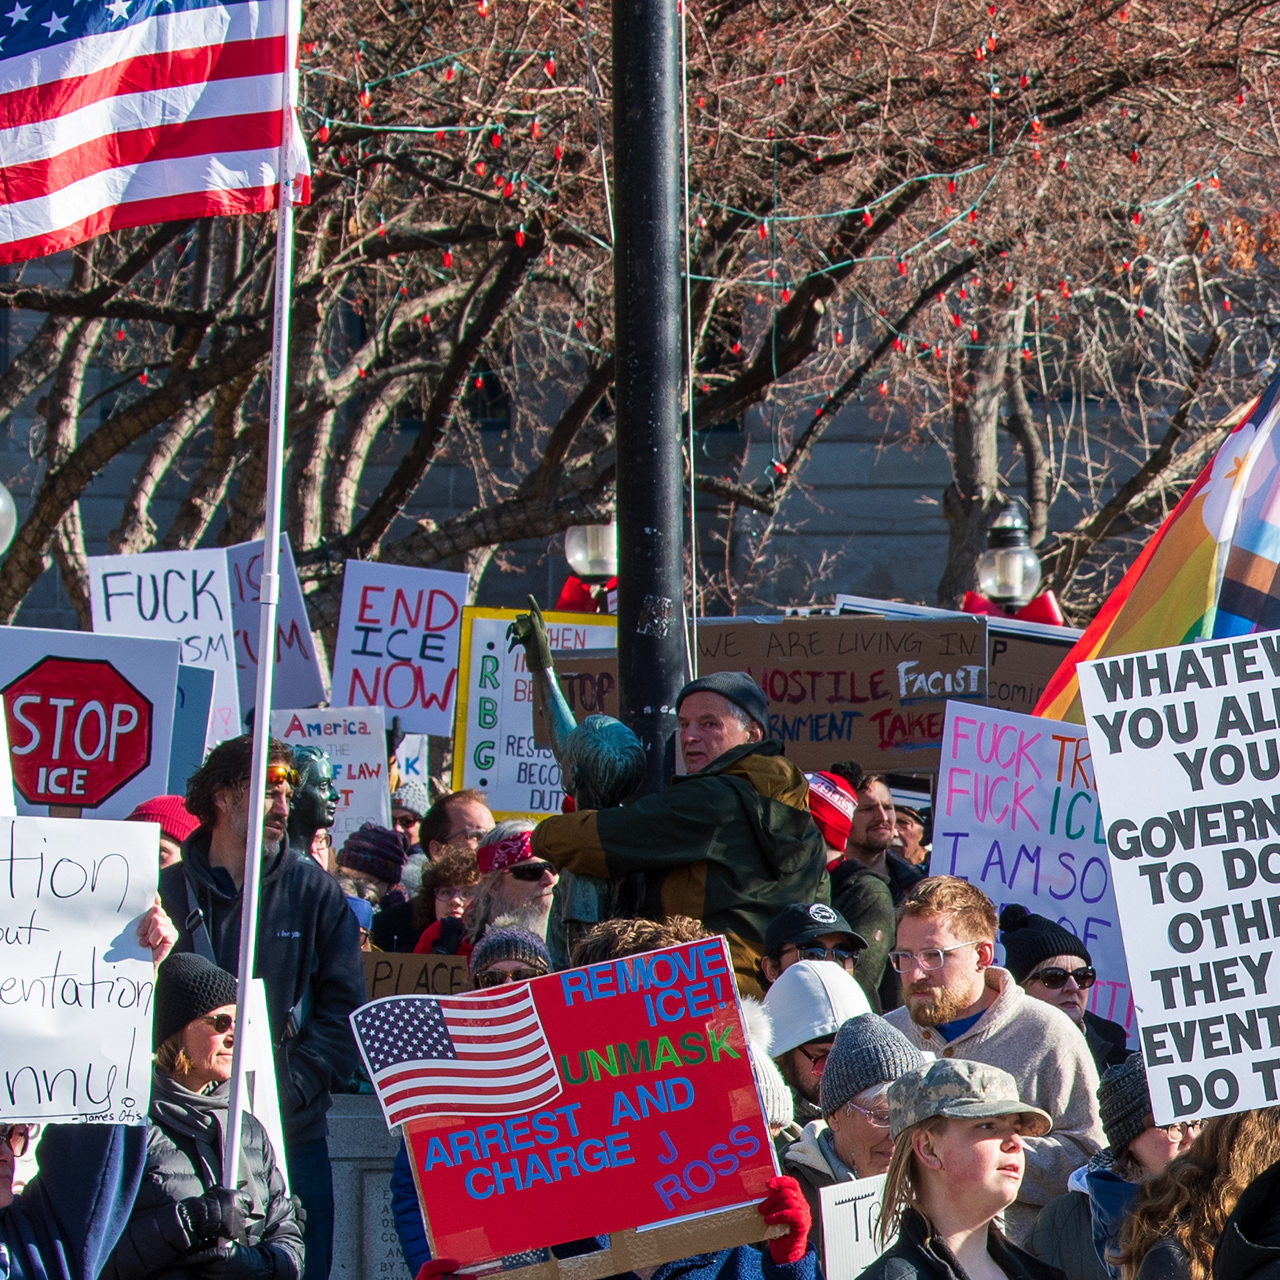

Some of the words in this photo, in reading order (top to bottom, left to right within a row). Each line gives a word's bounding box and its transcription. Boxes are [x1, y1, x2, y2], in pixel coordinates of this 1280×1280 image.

[101, 569, 223, 623] FUCK
[357, 586, 459, 632] END
[351, 626, 446, 662] ICE
[547, 628, 587, 650] HEN
[698, 631, 741, 658] WE
[766, 631, 824, 658] ARE
[837, 632, 923, 655] LIVING
[938, 632, 977, 656] IN
[348, 661, 457, 712] NOW
[560, 672, 615, 714] TOP
[897, 660, 985, 698] FACIST
[10, 695, 138, 763] STOP
[283, 713, 371, 738] America
[951, 716, 1042, 780] FUCK
[1092, 700, 1199, 755] YOU
[36, 767, 87, 795] ICE
[346, 762, 381, 780] LAW
[945, 766, 1040, 832] FUCK
[0, 820, 130, 913] tion
[942, 831, 970, 881] I
[980, 839, 1042, 897] AM
[1049, 852, 1109, 905] SO
[1138, 861, 1204, 905] TO
[0, 947, 153, 1016] entation
[560, 940, 727, 1006] REMOVE
[1149, 950, 1273, 1011] THEY
[644, 976, 727, 1027] ICE!
[559, 1025, 741, 1086] UNMASK
[83, 1113, 115, 1124] James
[1167, 1068, 1240, 1118] DO
[424, 1102, 581, 1171] ARREST
[610, 1076, 695, 1127] AND
[463, 1132, 635, 1201] CHARGE
[656, 1130, 679, 1166] J
[652, 1124, 761, 1212] ROSS
